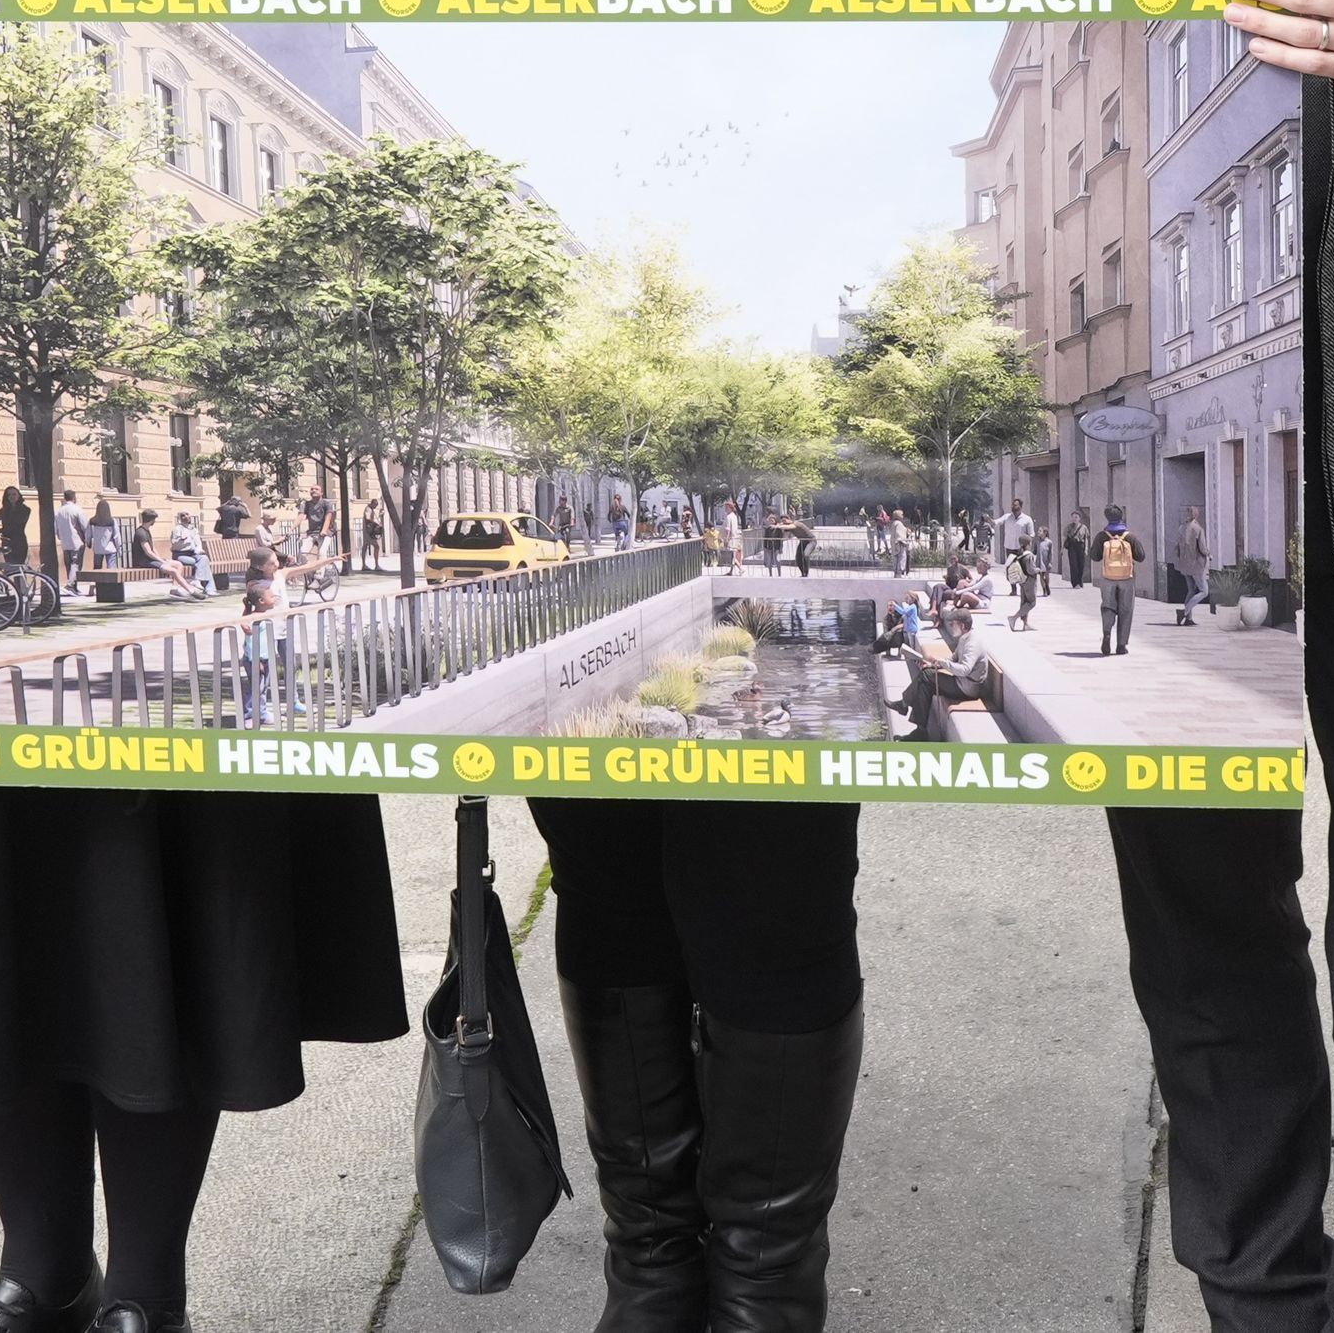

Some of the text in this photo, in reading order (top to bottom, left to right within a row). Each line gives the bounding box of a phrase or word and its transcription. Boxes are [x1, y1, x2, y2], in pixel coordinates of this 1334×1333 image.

[559, 627, 637, 690] ALSERBACH
[10, 726, 205, 773] GRÜNEN
[217, 738, 440, 779] HERNALS
[512, 745, 591, 782] DIE
[604, 739, 806, 785] GRÜNEN
[820, 749, 1050, 790] HERNALS
[1125, 754, 1207, 791] DIE
